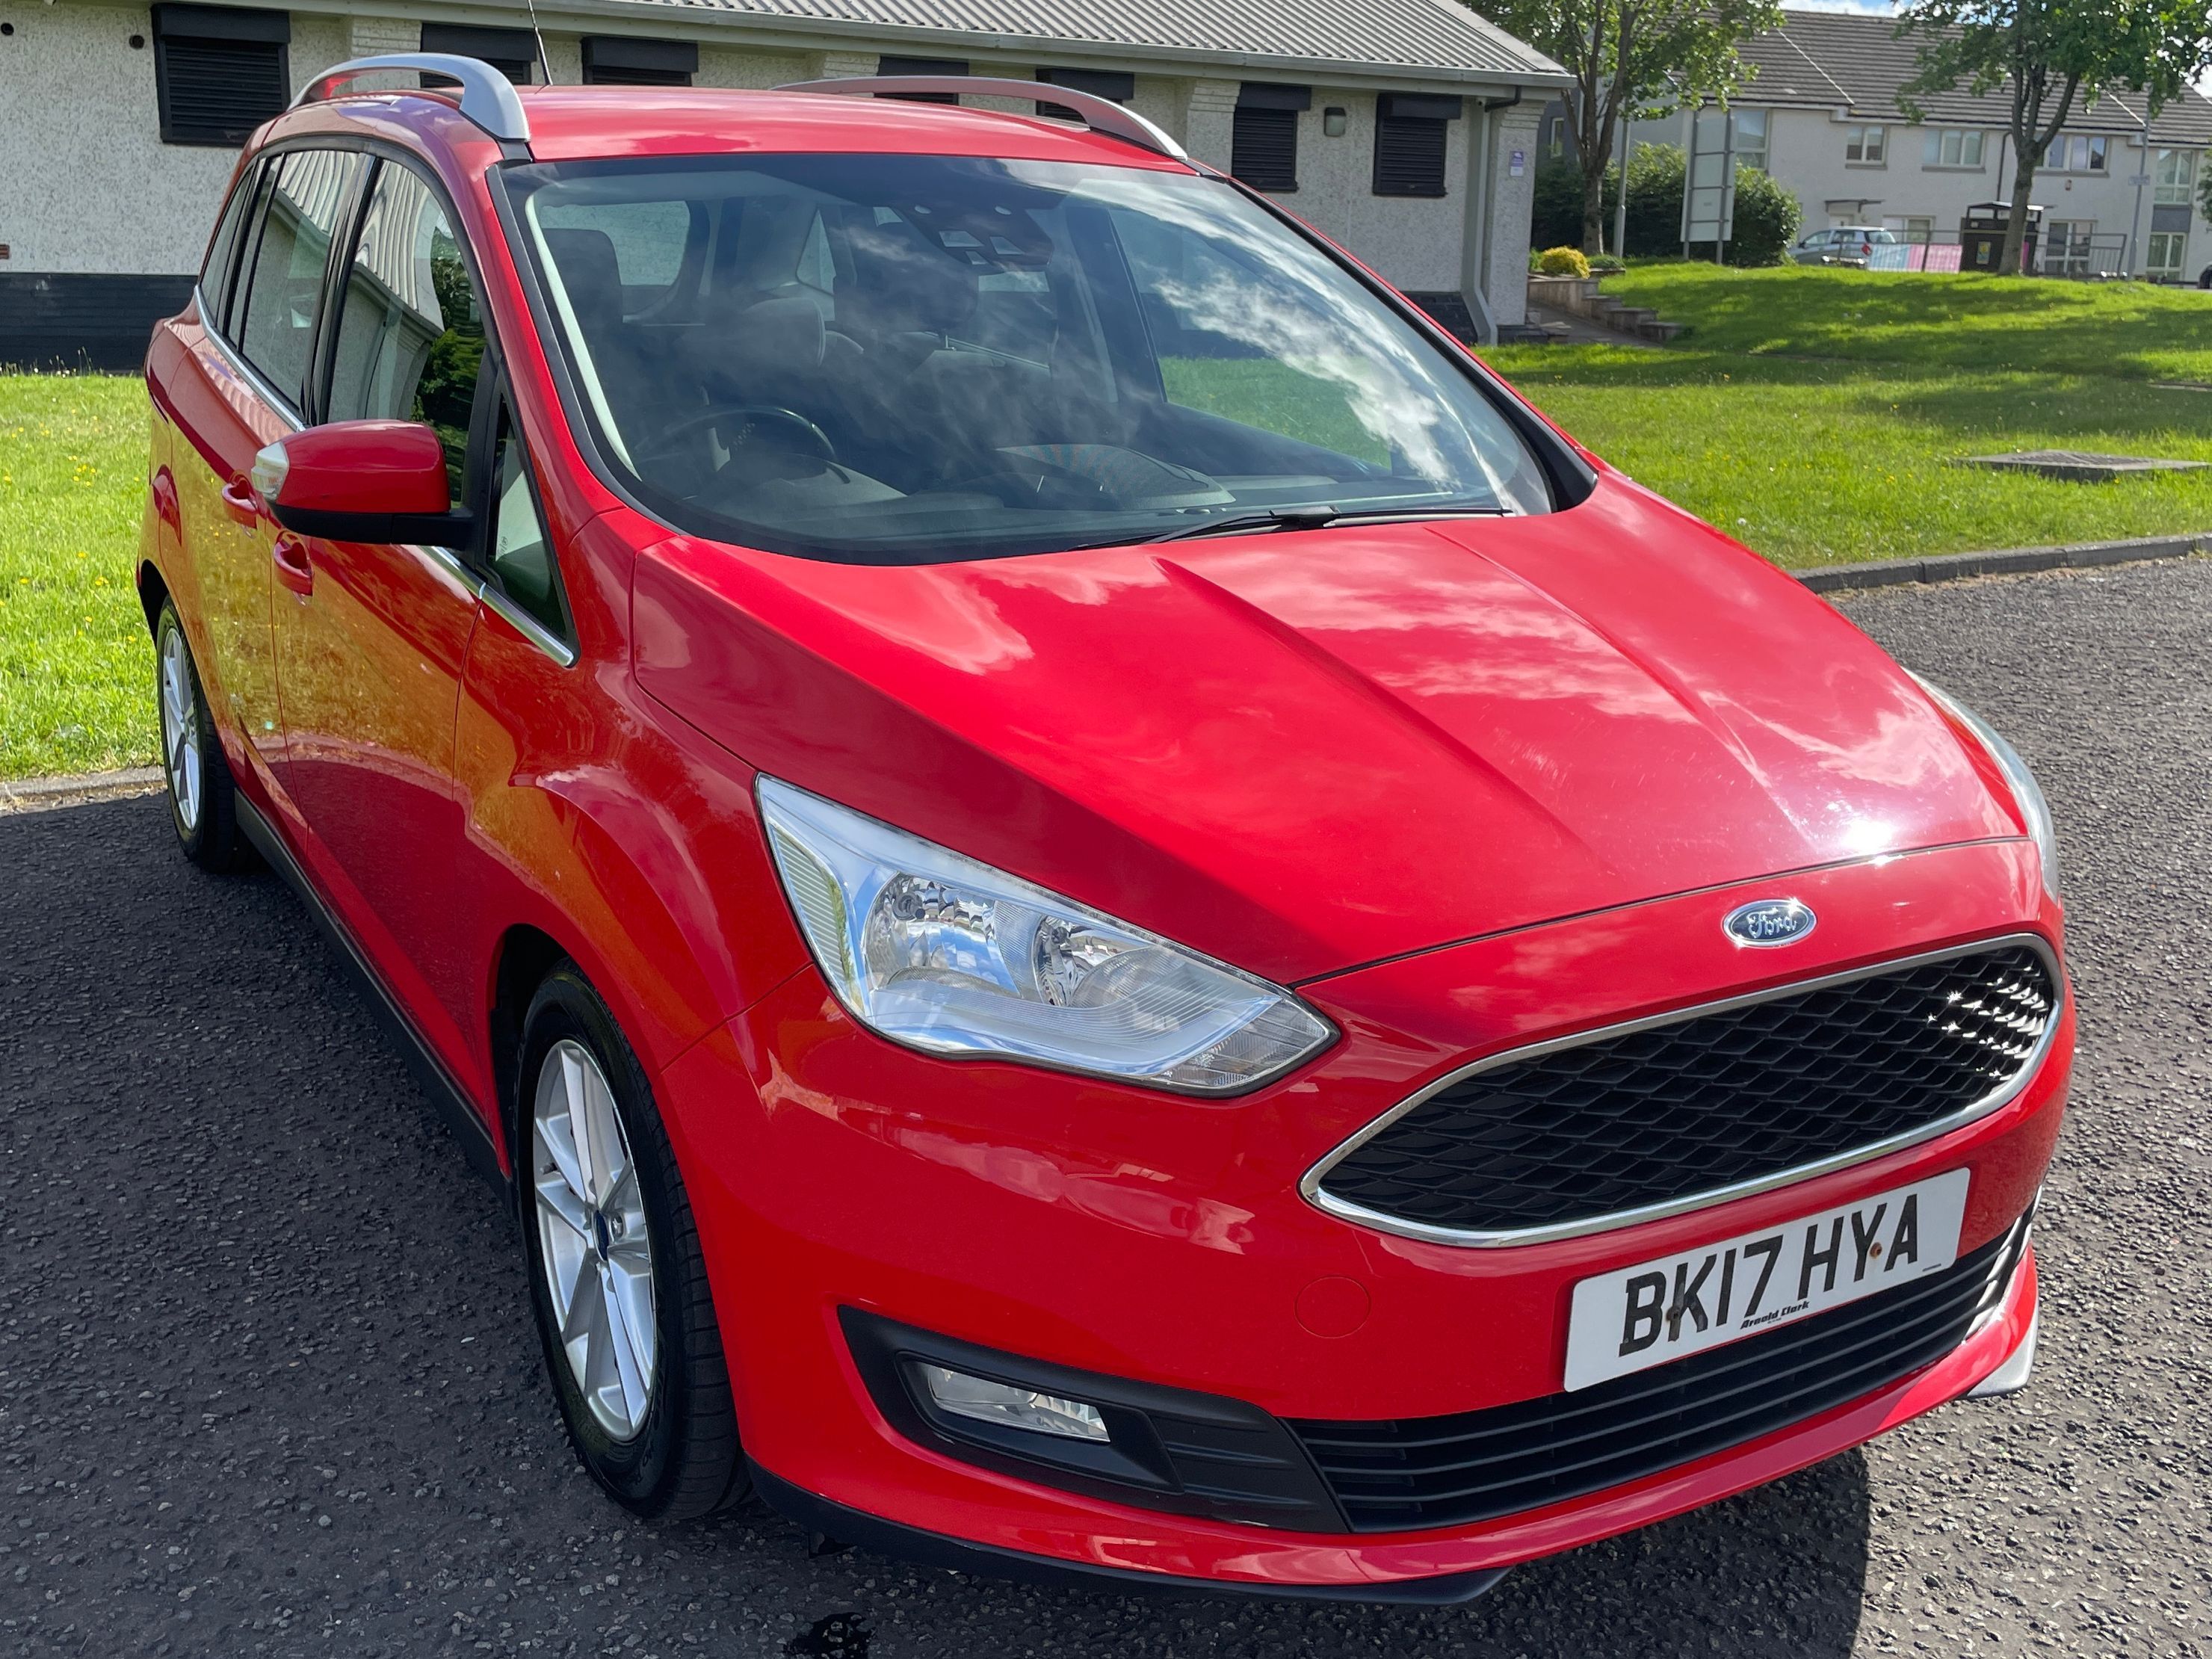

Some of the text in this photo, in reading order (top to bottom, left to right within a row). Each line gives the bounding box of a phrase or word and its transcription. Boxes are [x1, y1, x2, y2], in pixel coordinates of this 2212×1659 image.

[1746, 906, 1797, 939] Ford
[1619, 1193, 1918, 1357] BK17 HYA
[1740, 1300, 1810, 1329] Arnold Clark
